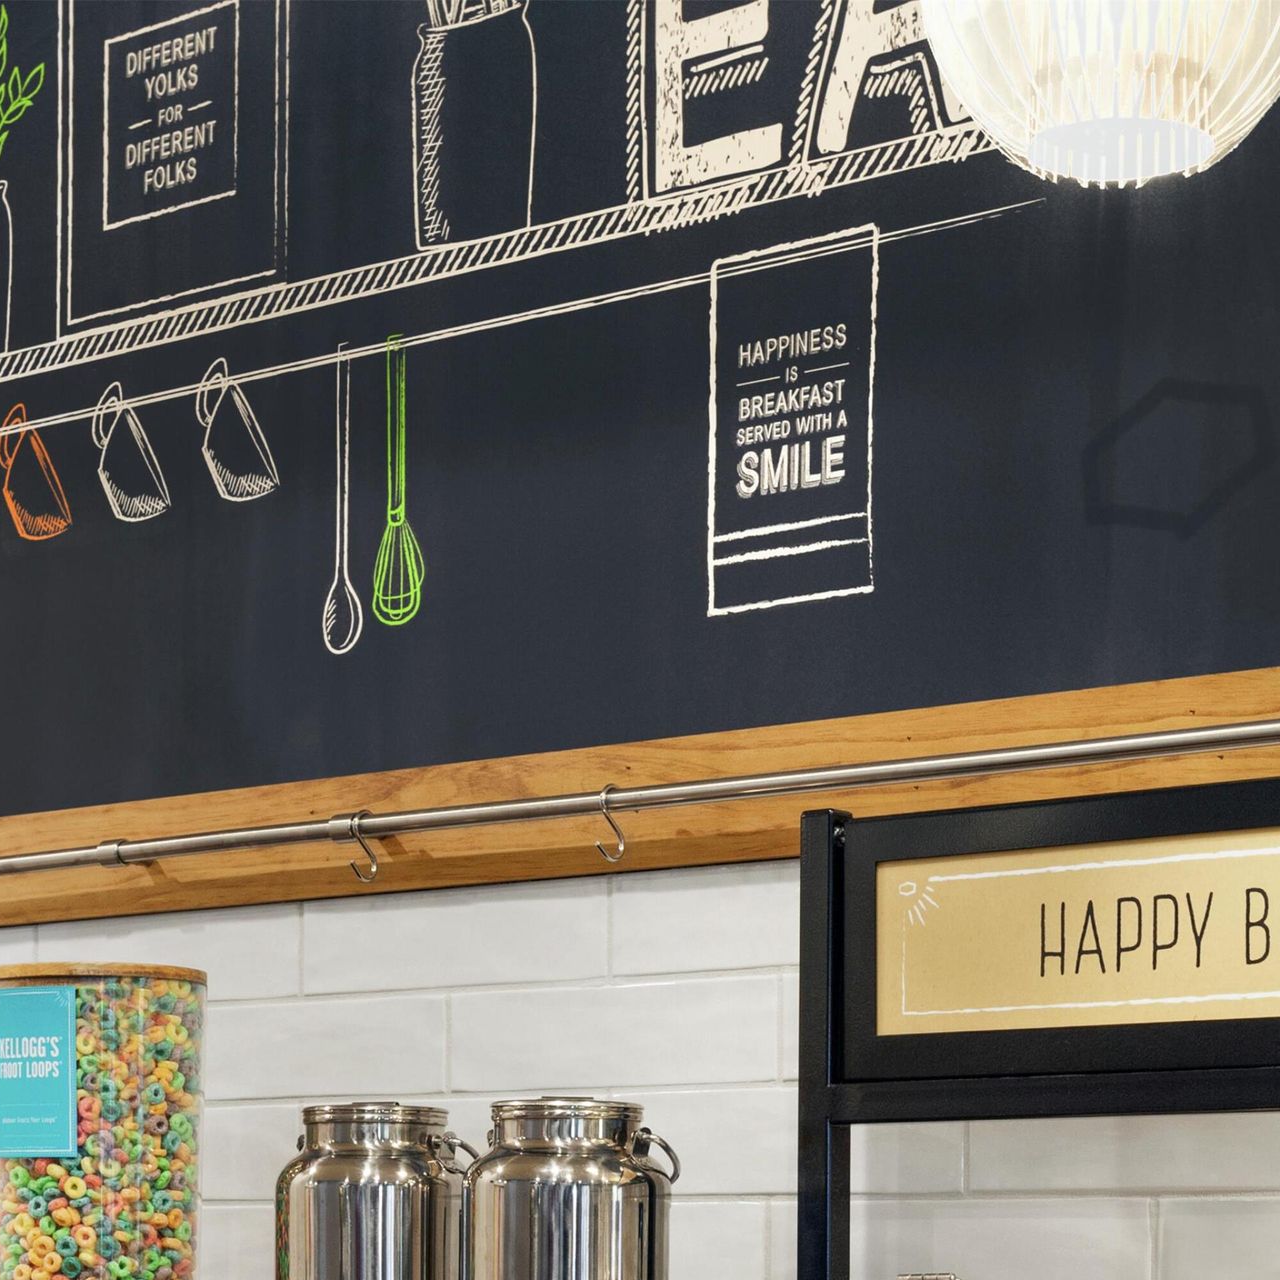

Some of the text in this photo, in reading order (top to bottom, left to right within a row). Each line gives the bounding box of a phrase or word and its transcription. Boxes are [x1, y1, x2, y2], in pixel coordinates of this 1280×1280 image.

[125, 26, 218, 78] DIFFERENT
[145, 63, 199, 101] YOLKS
[158, 104, 183, 127] FOR
[125, 120, 217, 169] DIFFERENT
[144, 157, 197, 194] FOLKS
[738, 323, 847, 368] HAPPINESS
[785, 366, 798, 383] IS
[738, 379, 846, 422] BREAKFAST
[736, 409, 848, 446] SERVED WITH A
[736, 434, 846, 499] SMILE
[1040, 891, 1213, 977] HAPPY
[0, 1035, 60, 1059] KELLOGG'S
[25, 1061, 60, 1078] LOOPS
